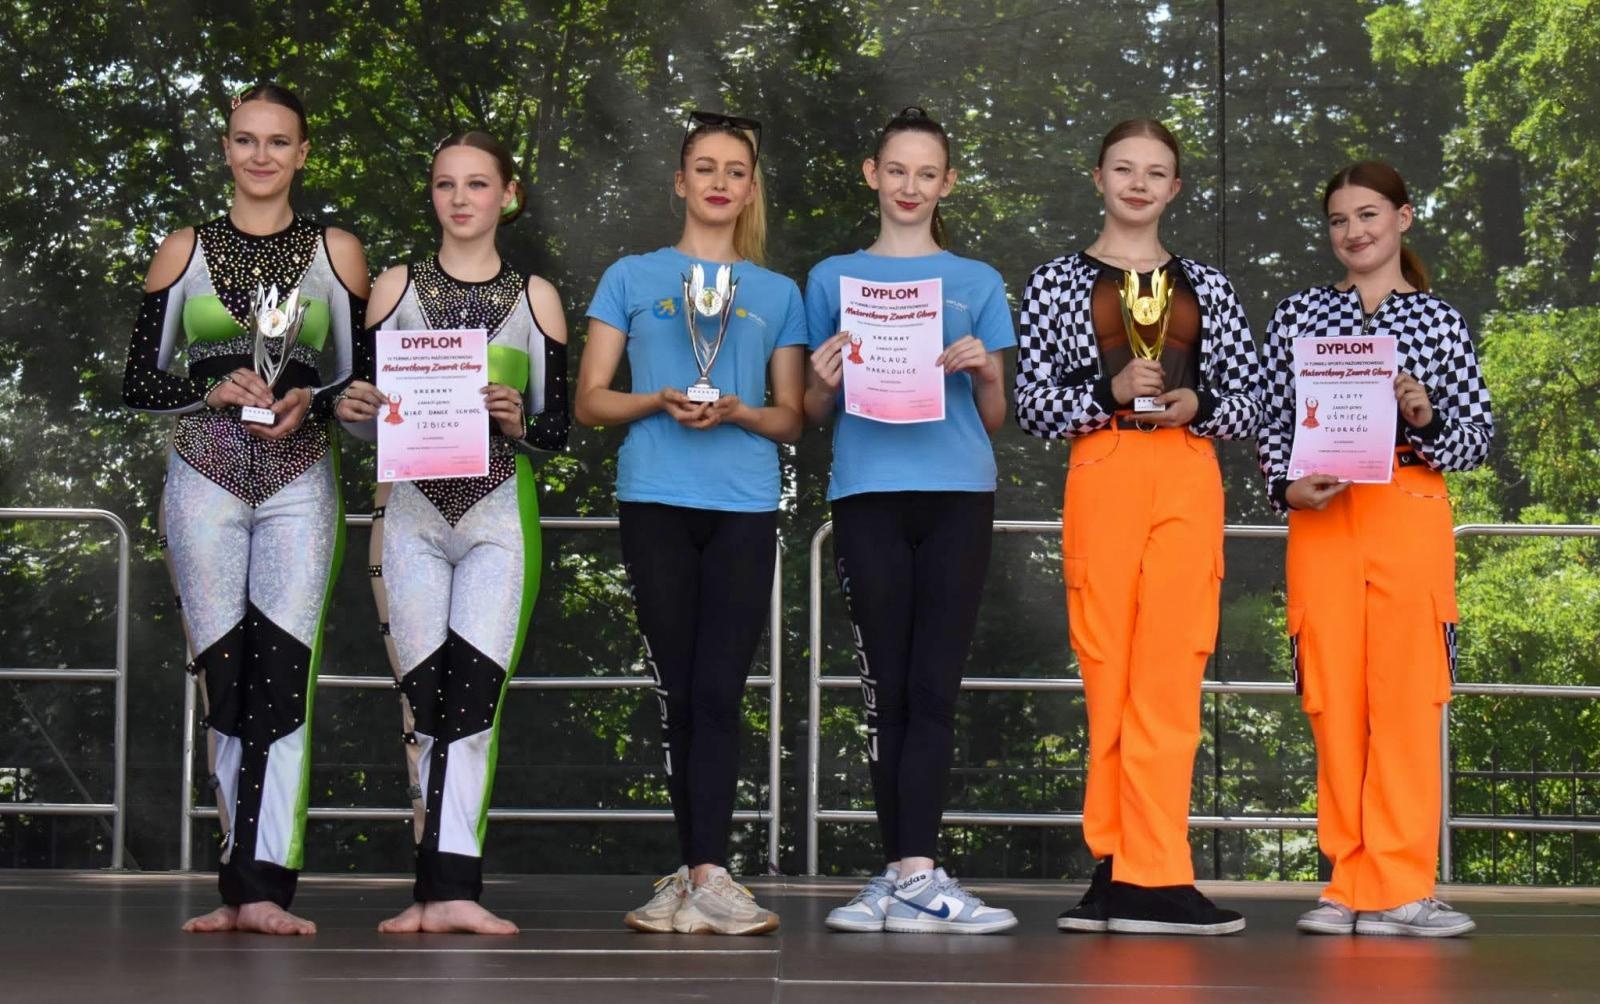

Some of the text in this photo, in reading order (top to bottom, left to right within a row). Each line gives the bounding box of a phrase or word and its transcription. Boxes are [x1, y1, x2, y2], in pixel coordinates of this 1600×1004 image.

[862, 286, 919, 300] DYPLOM
[401, 336, 462, 349] DYPLOM
[1316, 342, 1374, 355] DYPLOM
[870, 354, 908, 364] APLAUZ
[1327, 411, 1368, 420] UŚMIECH
